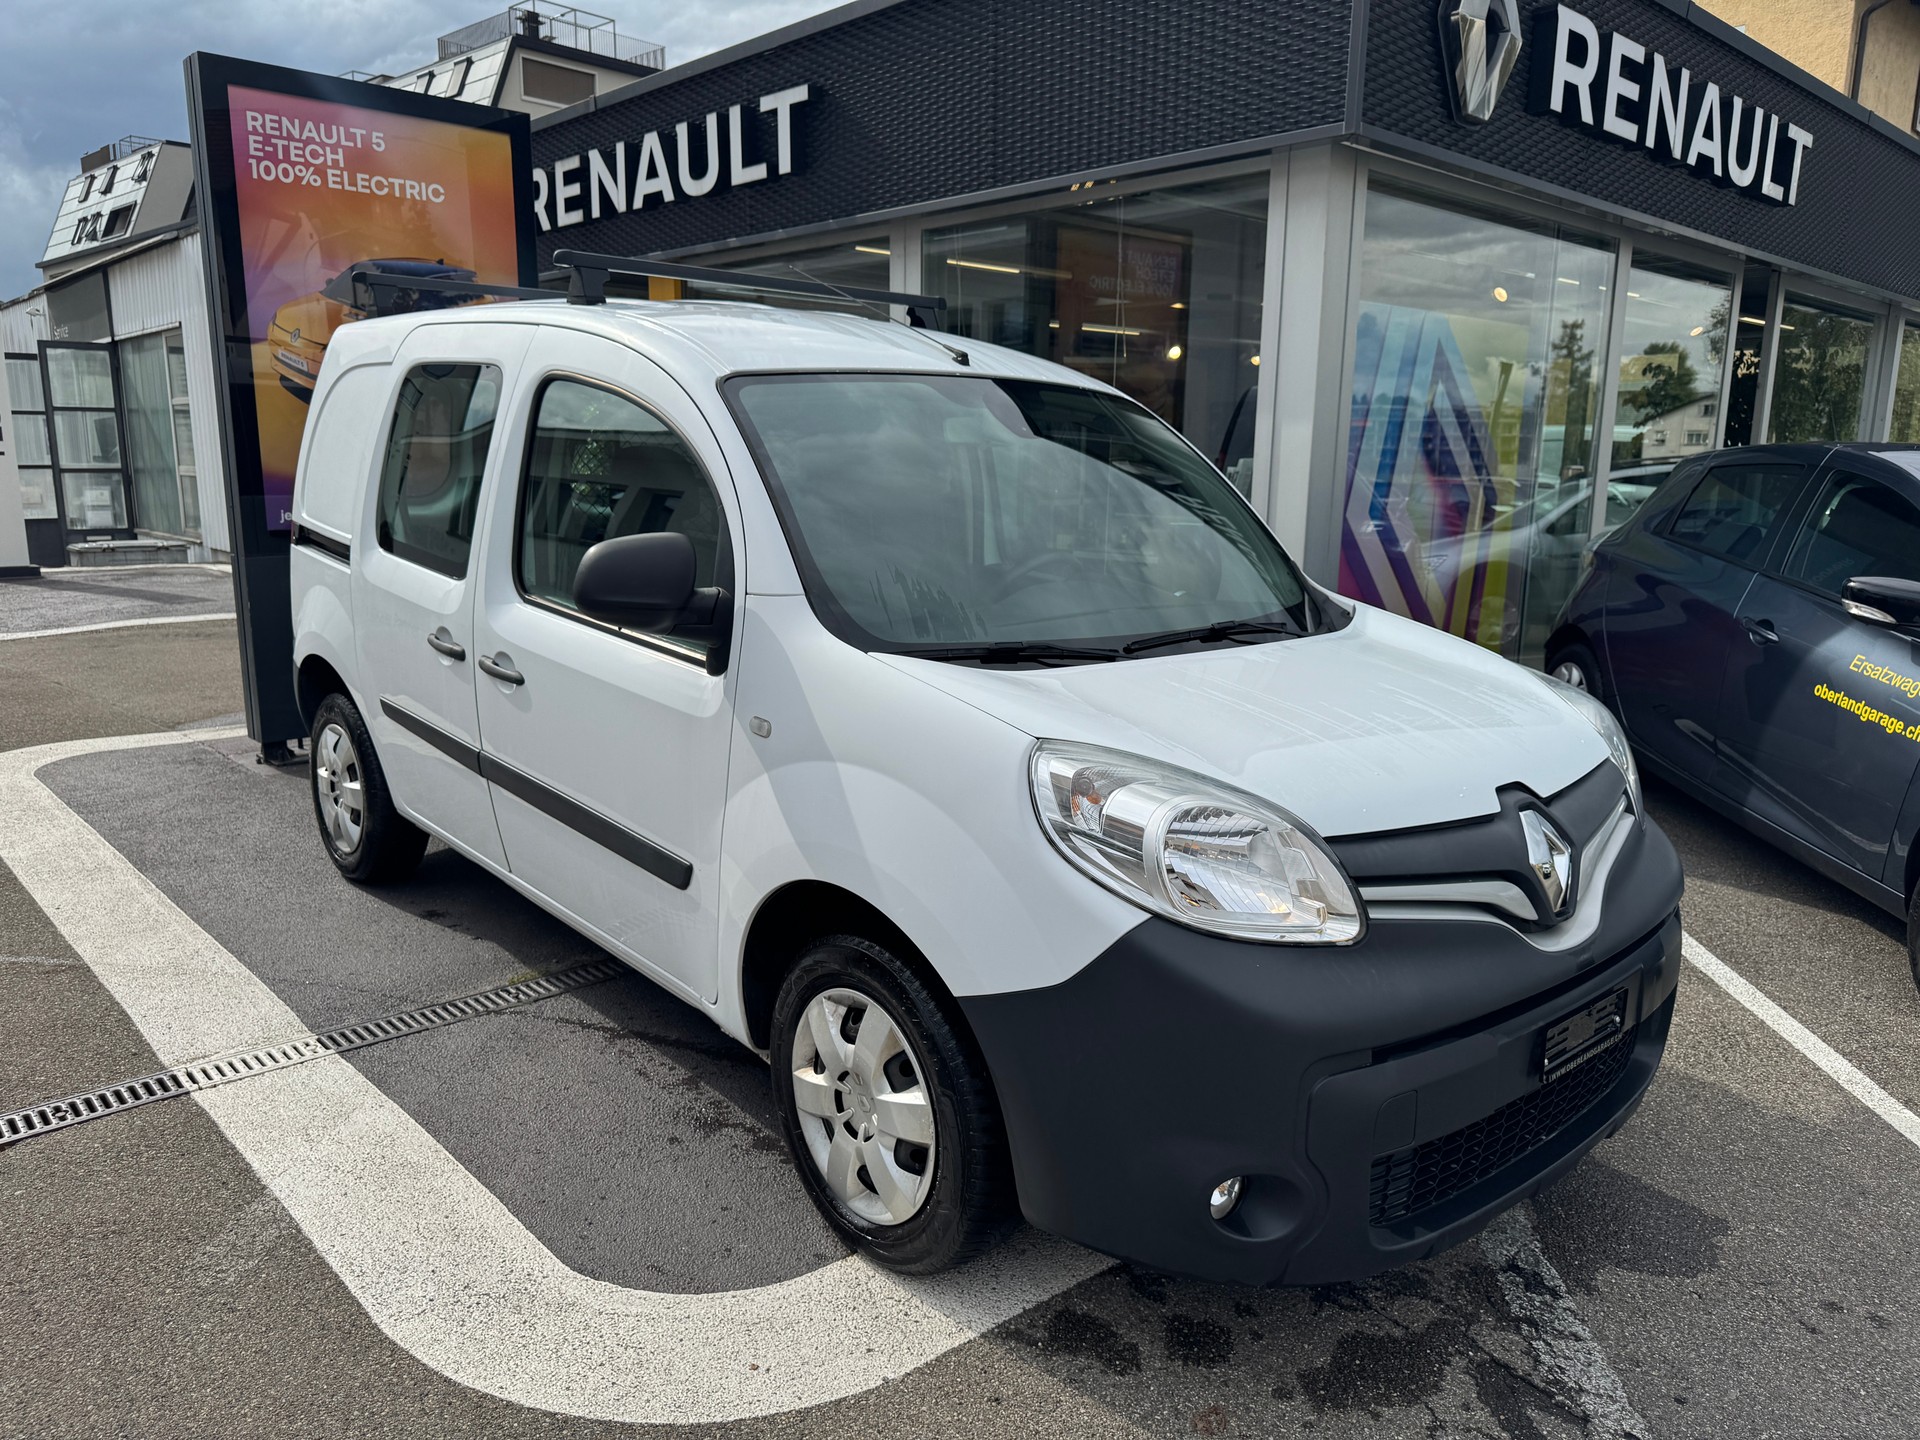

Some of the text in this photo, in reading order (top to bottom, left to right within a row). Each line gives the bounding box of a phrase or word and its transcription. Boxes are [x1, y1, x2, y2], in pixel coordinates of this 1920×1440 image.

[1550, 3, 1813, 206] RENAULT
[246, 110, 385, 151] RENAULT 5
[248, 135, 344, 167] E-TECH
[248, 158, 445, 203] 100% ELECTRIC
[532, 84, 808, 232] RENAULT
[1849, 653, 1920, 699] Ersatzwag
[1814, 683, 1920, 743] oberlandgarage.ch
